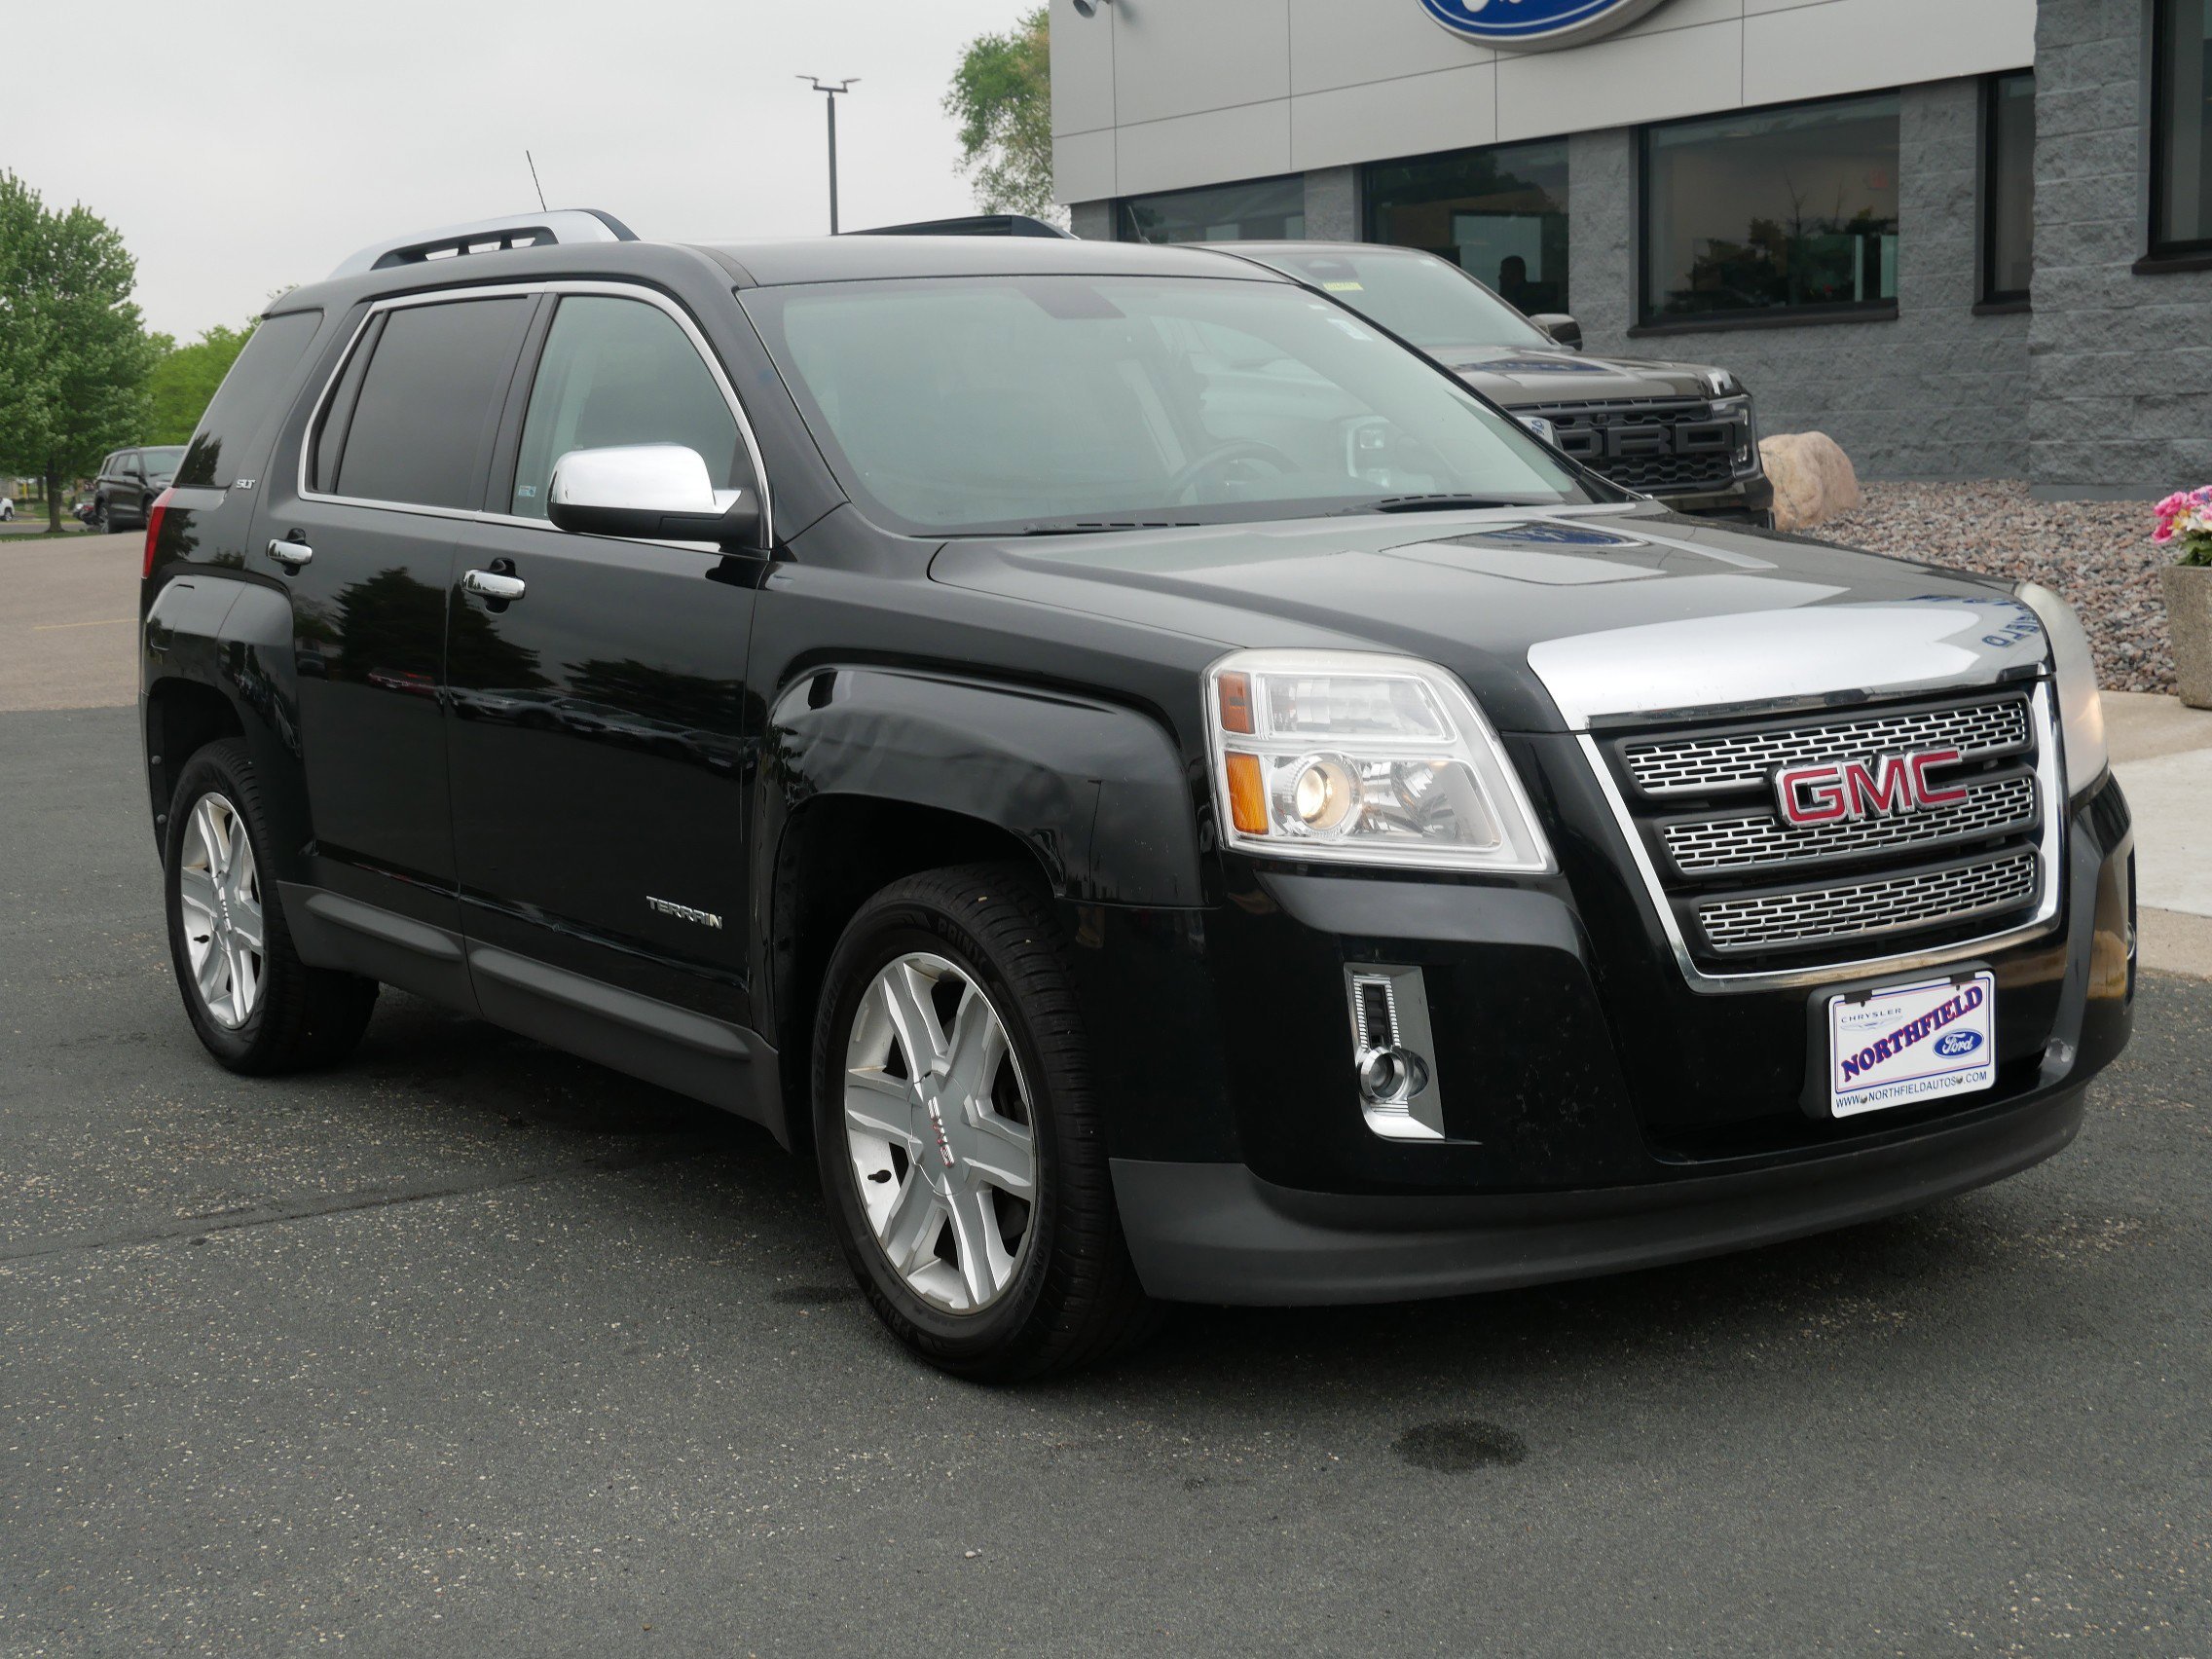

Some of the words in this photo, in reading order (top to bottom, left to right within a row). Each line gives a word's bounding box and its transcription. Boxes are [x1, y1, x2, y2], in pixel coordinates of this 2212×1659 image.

[237, 479, 256, 489] SLT
[1776, 748, 1970, 826] GMC
[646, 896, 722, 929] TERRAIN
[1842, 1009, 1901, 1022] CHRYSLER
[1841, 986, 1983, 1082] NORTHFIELD
[1942, 1033, 1974, 1053] Ford
[1836, 1072, 1986, 1107] WWWNORTHFIELDAUTOS.COM
